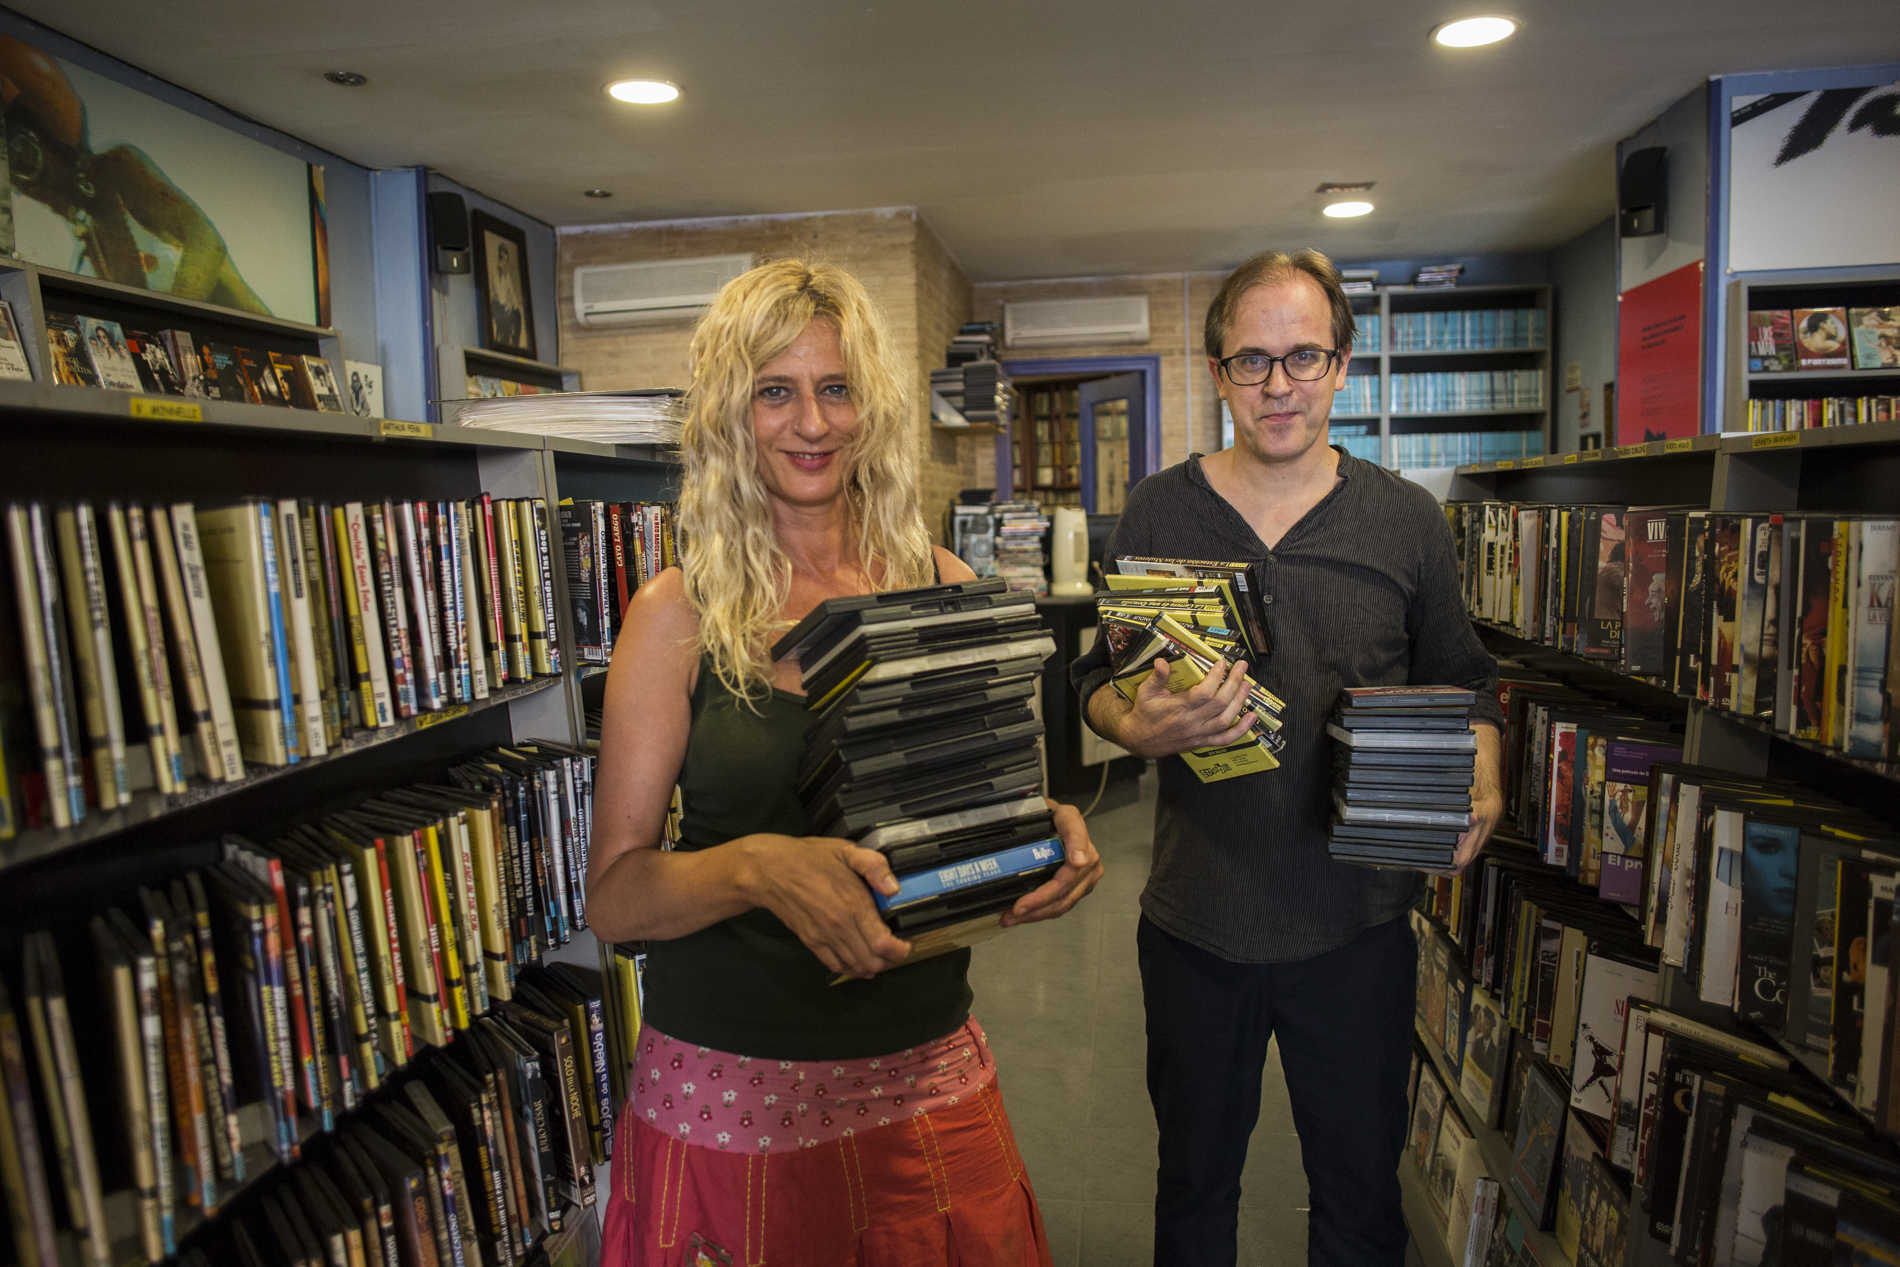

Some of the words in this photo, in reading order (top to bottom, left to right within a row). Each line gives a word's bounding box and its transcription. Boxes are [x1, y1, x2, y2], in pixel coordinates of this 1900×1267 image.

[540, 529, 548, 553] doce
[612, 513, 621, 543] LARGO
[615, 544, 623, 567] CAYO
[440, 559, 454, 608] HUMANA
[545, 579, 555, 620] llamada
[549, 621, 557, 642] una
[522, 841, 533, 897] INVASORES
[1607, 855, 1621, 868] El
[1756, 966, 1776, 979] The
[593, 1031, 607, 1073] Niebla
[564, 1055, 576, 1077] SOLO
[570, 1092, 582, 1119] NOCHE
[601, 1082, 609, 1094] de
[600, 1097, 613, 1137] Lejos
[537, 1128, 550, 1153] JULIO
